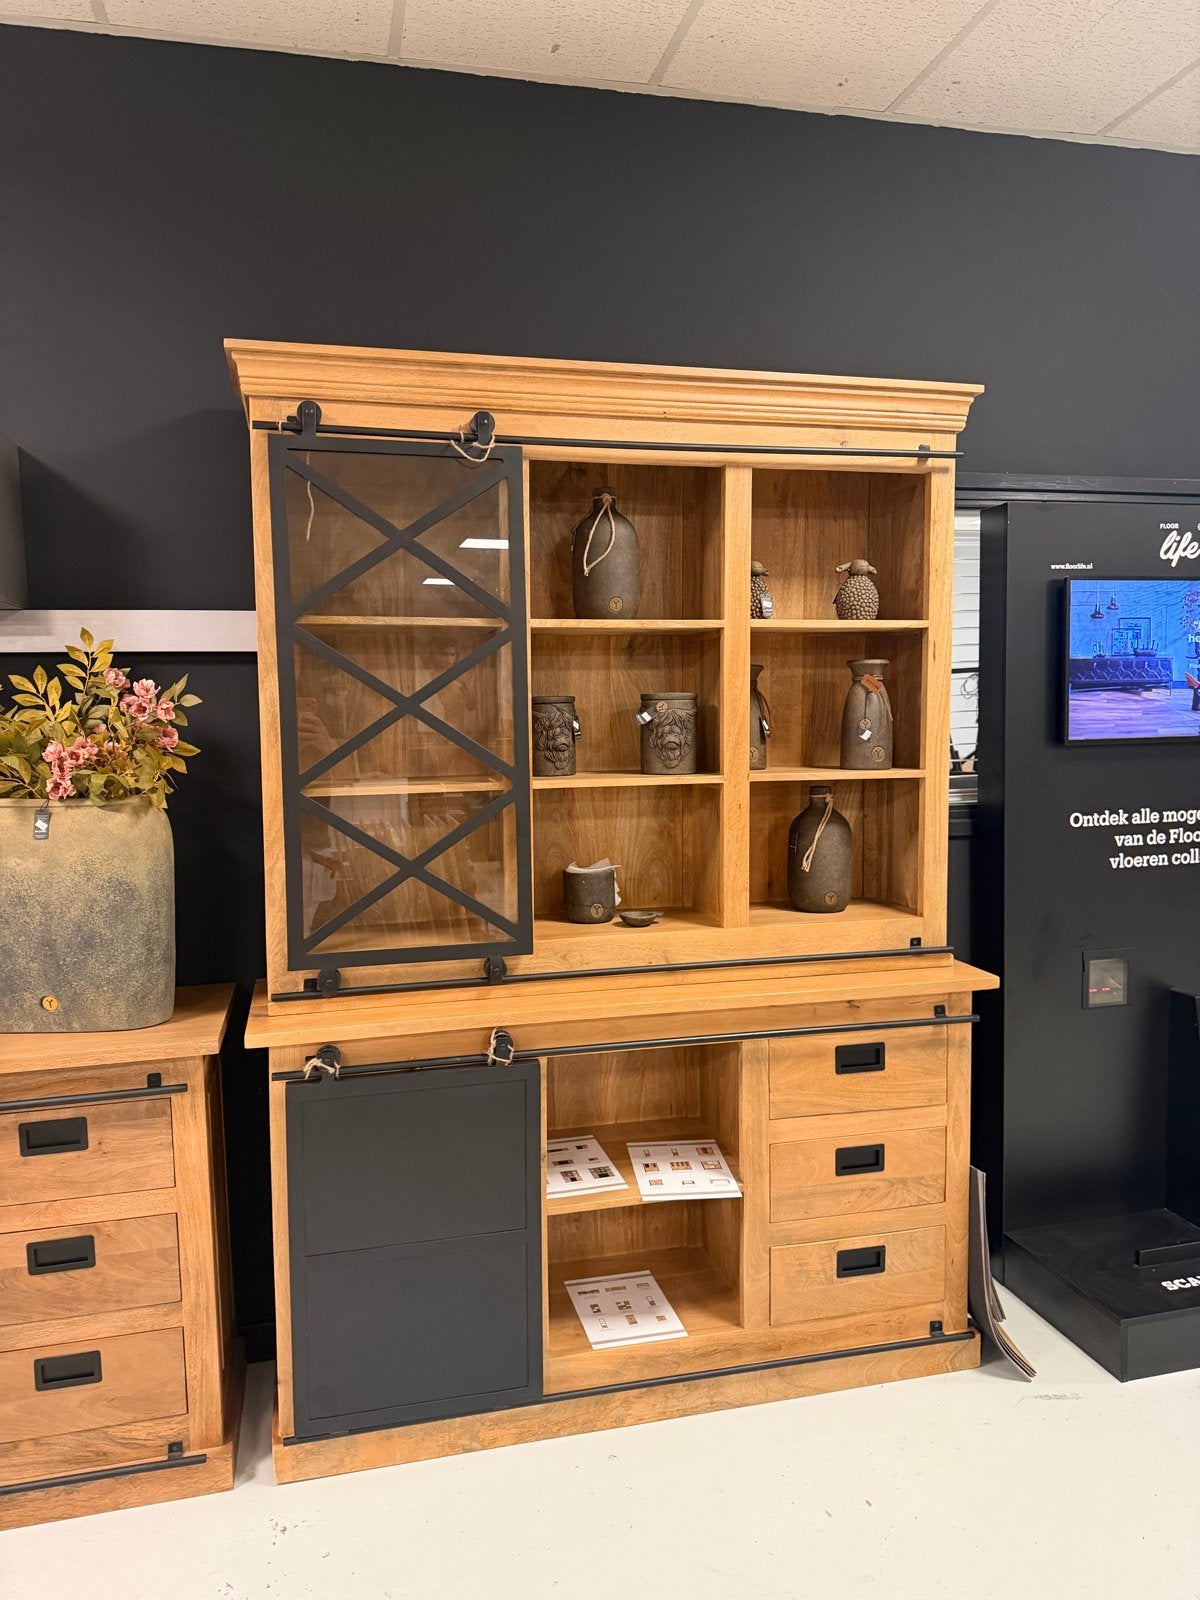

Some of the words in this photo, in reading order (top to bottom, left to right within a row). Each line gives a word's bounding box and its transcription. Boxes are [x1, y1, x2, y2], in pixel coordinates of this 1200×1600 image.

[1160, 530, 1200, 567] life
[1069, 809, 1129, 828] Ontdek
[1131, 808, 1160, 825] alle
[1114, 834, 1144, 847] van
[1146, 829, 1167, 845] de
[1109, 853, 1169, 869] vloeren
